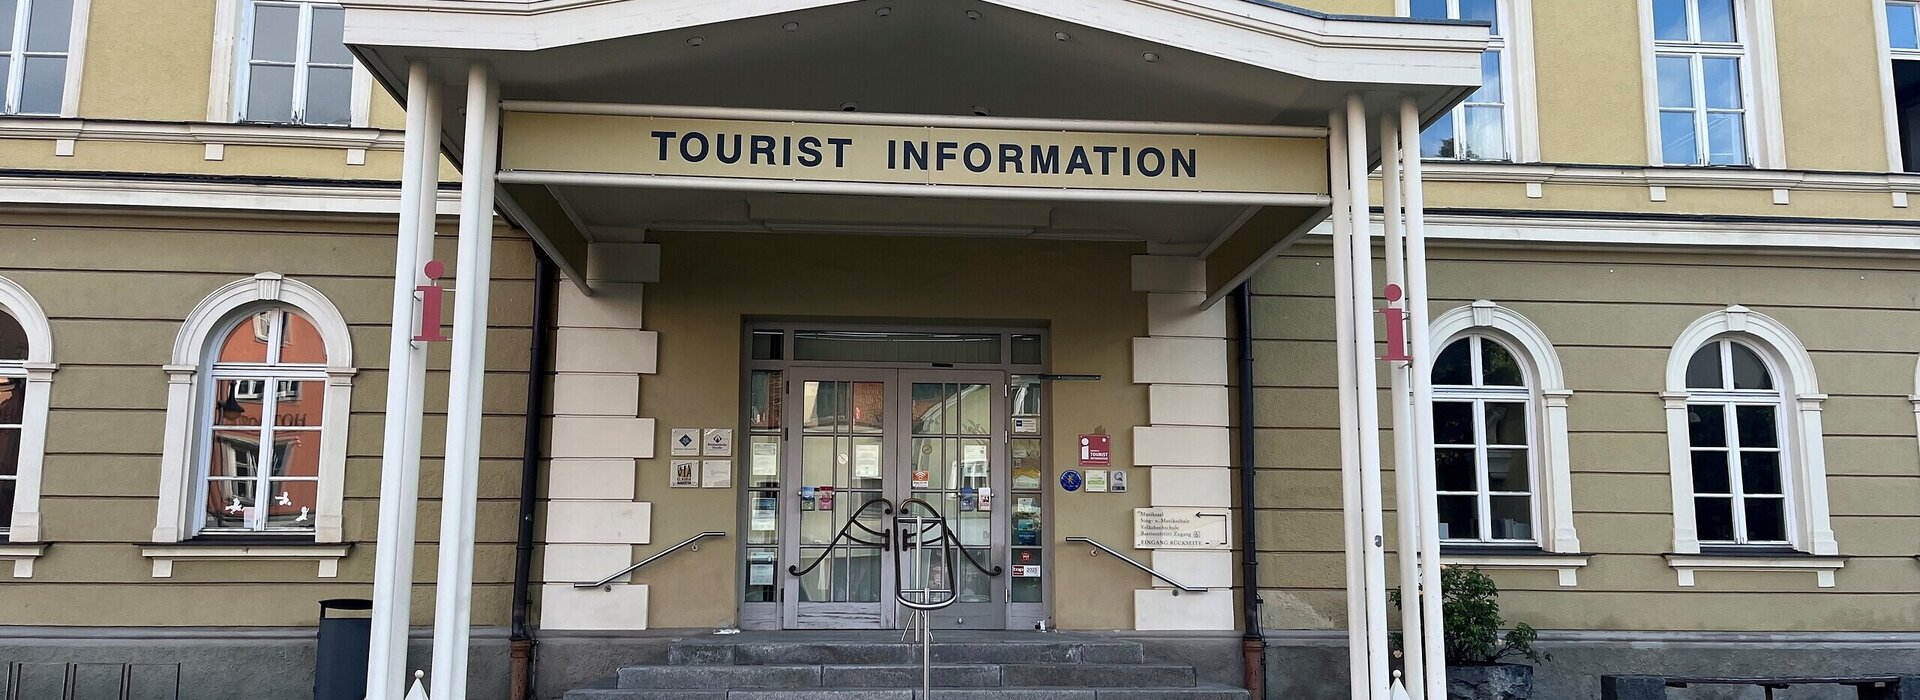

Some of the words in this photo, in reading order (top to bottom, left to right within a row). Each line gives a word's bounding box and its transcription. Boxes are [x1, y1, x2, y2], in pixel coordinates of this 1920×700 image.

[651, 131, 852, 168] TOURIST
[887, 139, 1197, 178] INFORMATION
[413, 259, 448, 342] i
[1379, 283, 1414, 361] i
[677, 463, 692, 477] VIA
